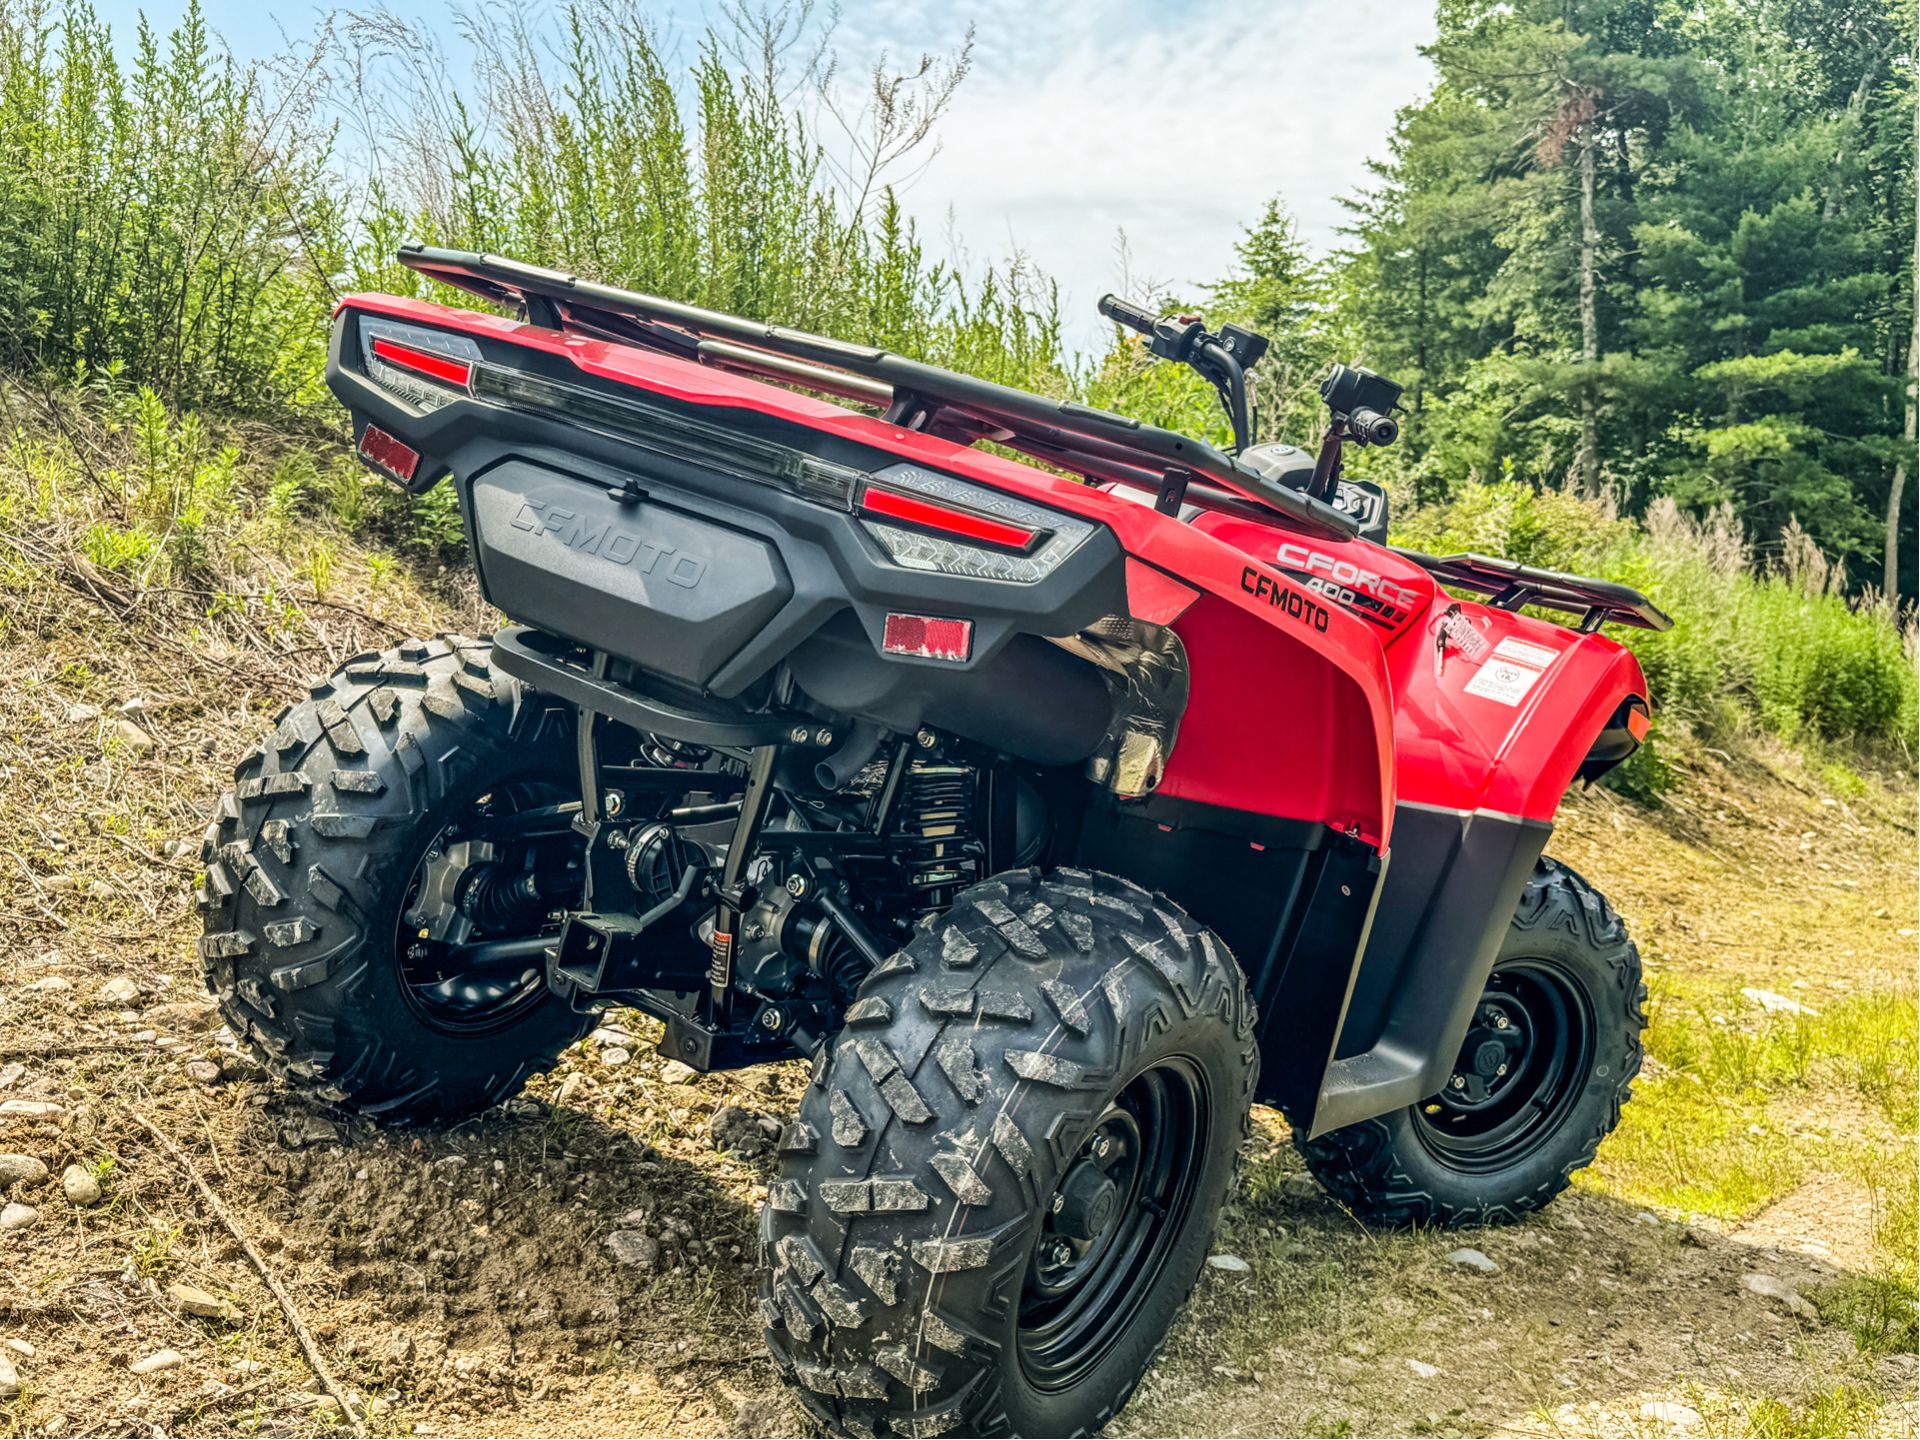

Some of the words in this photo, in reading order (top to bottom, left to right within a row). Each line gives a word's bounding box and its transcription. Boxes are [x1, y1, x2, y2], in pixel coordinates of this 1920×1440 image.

[510, 500, 707, 590] CFMOTO
[1277, 543, 1417, 609] CFORCE
[1241, 566, 1329, 633] CFMOTO
[1305, 577, 1355, 604] 400
